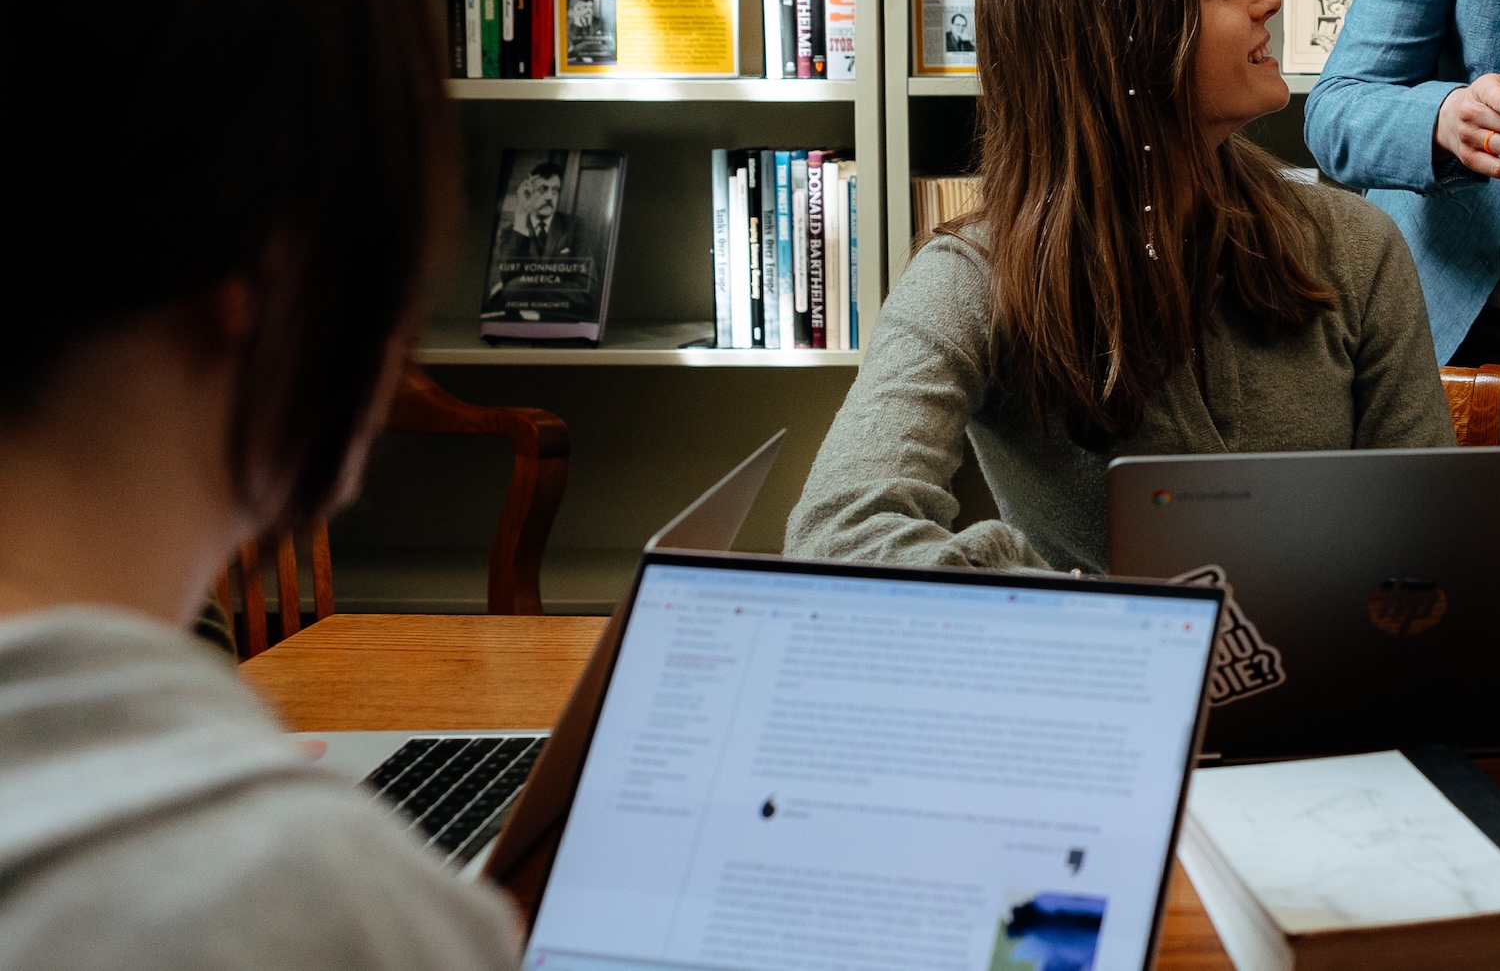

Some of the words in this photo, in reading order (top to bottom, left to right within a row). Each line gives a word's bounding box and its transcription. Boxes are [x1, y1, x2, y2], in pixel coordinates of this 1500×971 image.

[808, 167, 822, 234] DONALD
[717, 238, 726, 258] Over
[765, 239, 775, 259] Over
[499, 263, 520, 271] KURT
[524, 263, 587, 273] VONNEGUT'S
[520, 275, 561, 283] AMERICA
[810, 238, 824, 329] BARTHELME
